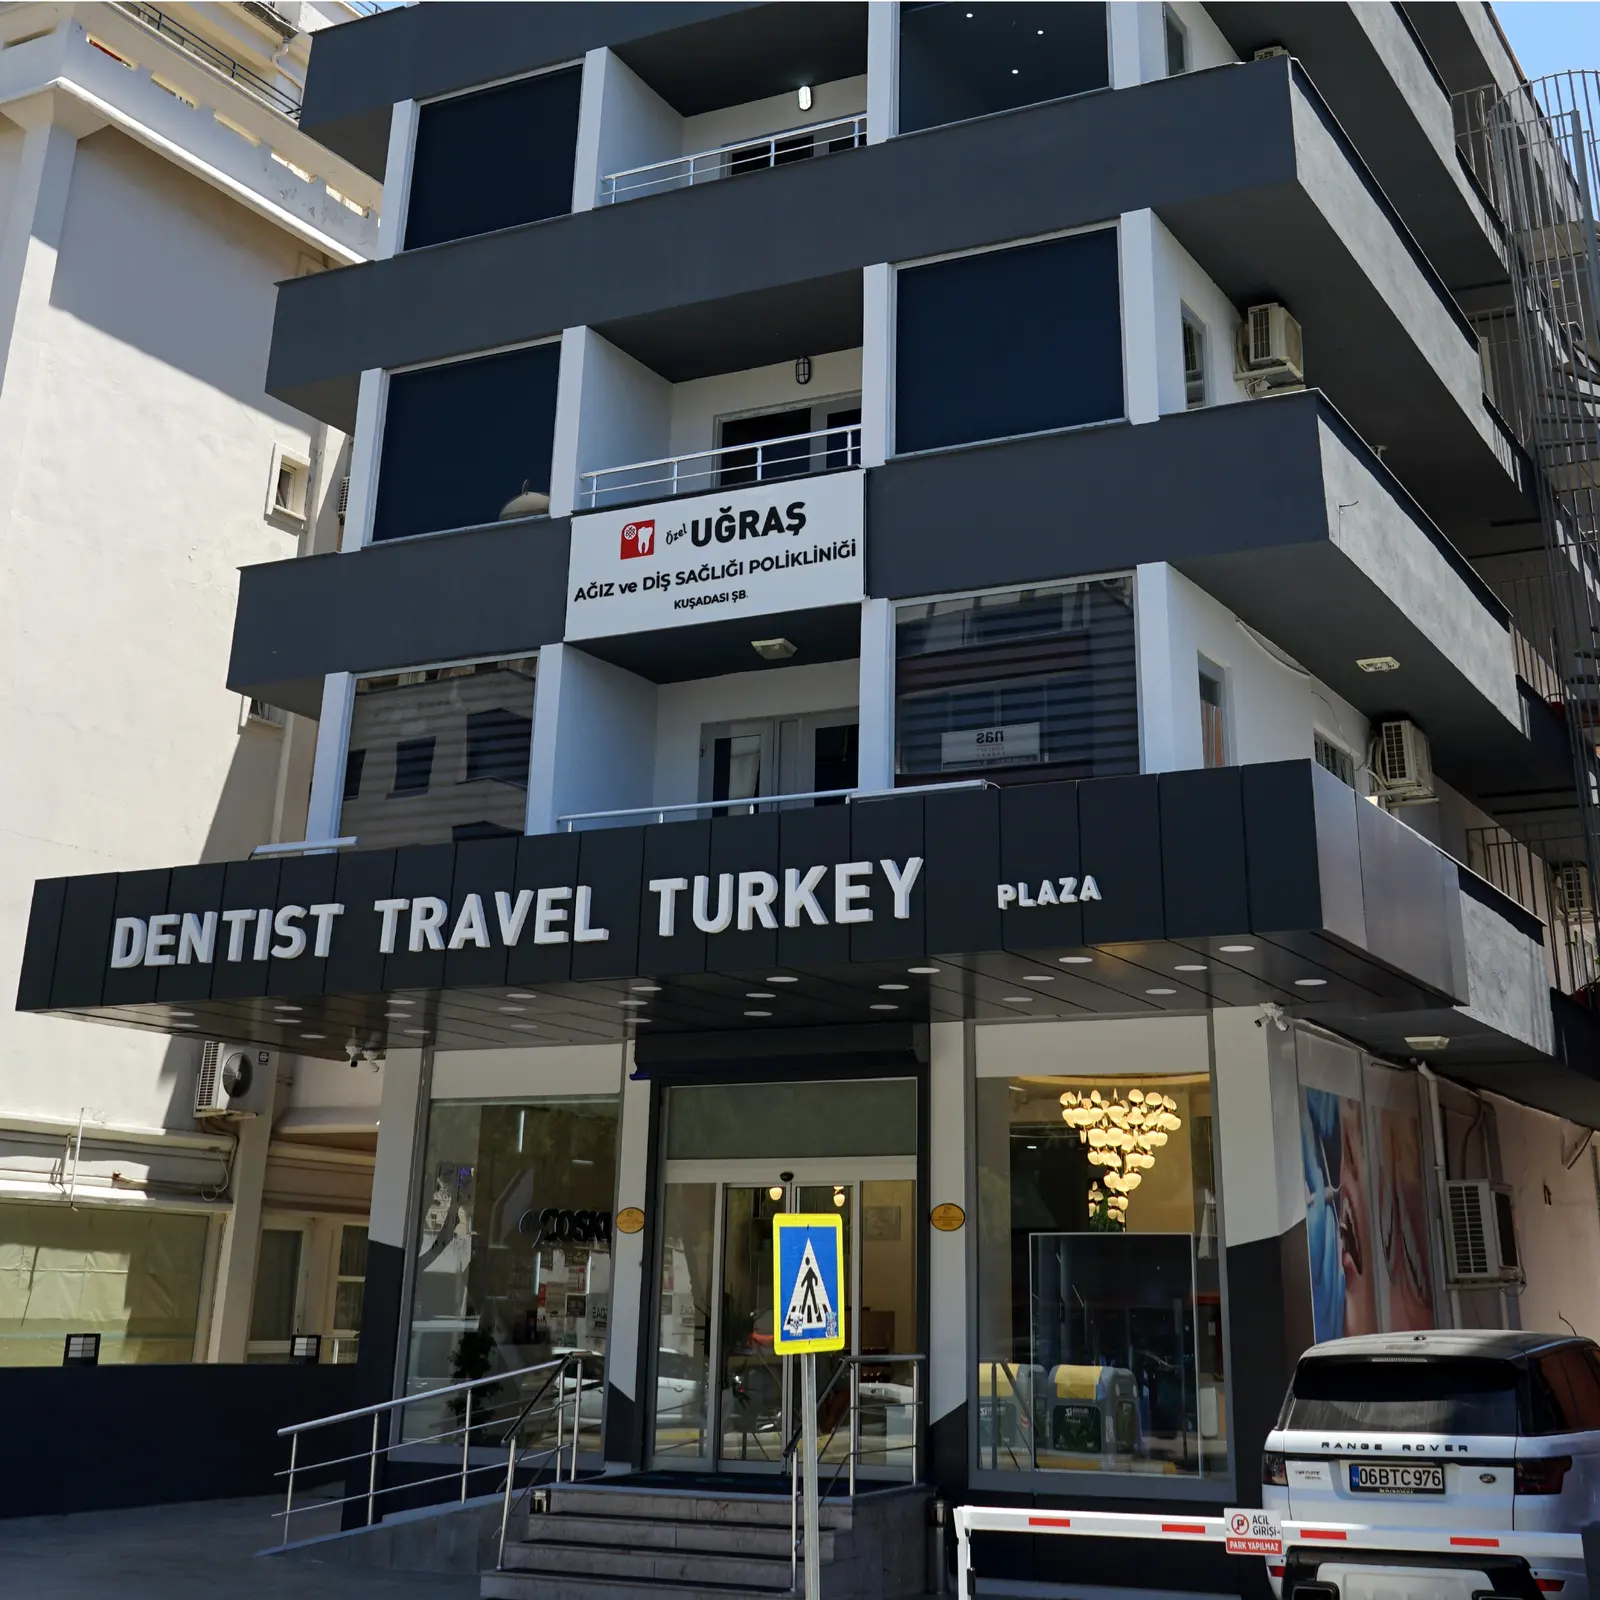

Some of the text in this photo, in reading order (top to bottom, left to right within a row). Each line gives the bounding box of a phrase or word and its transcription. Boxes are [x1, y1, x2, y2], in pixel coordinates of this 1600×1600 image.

[665, 501, 807, 548] Özel UĞRAŞ
[573, 538, 857, 602] AĞIZ ve DİŞ SAĞLIĞI POLİKLİNİĞİ
[673, 589, 749, 611] KUŞADASI ŞB.
[110, 856, 1103, 969] DENTIST TRAVEL TURKEY PLAZA
[1321, 1441, 1469, 1452] RANGE ROVER
[1359, 1467, 1442, 1488] 06BTC976
[1252, 1514, 1270, 1526] ACİL
[1252, 1525, 1277, 1538] GİRİŞİ
[1229, 1540, 1280, 1552] PARK YAPILMAZ
